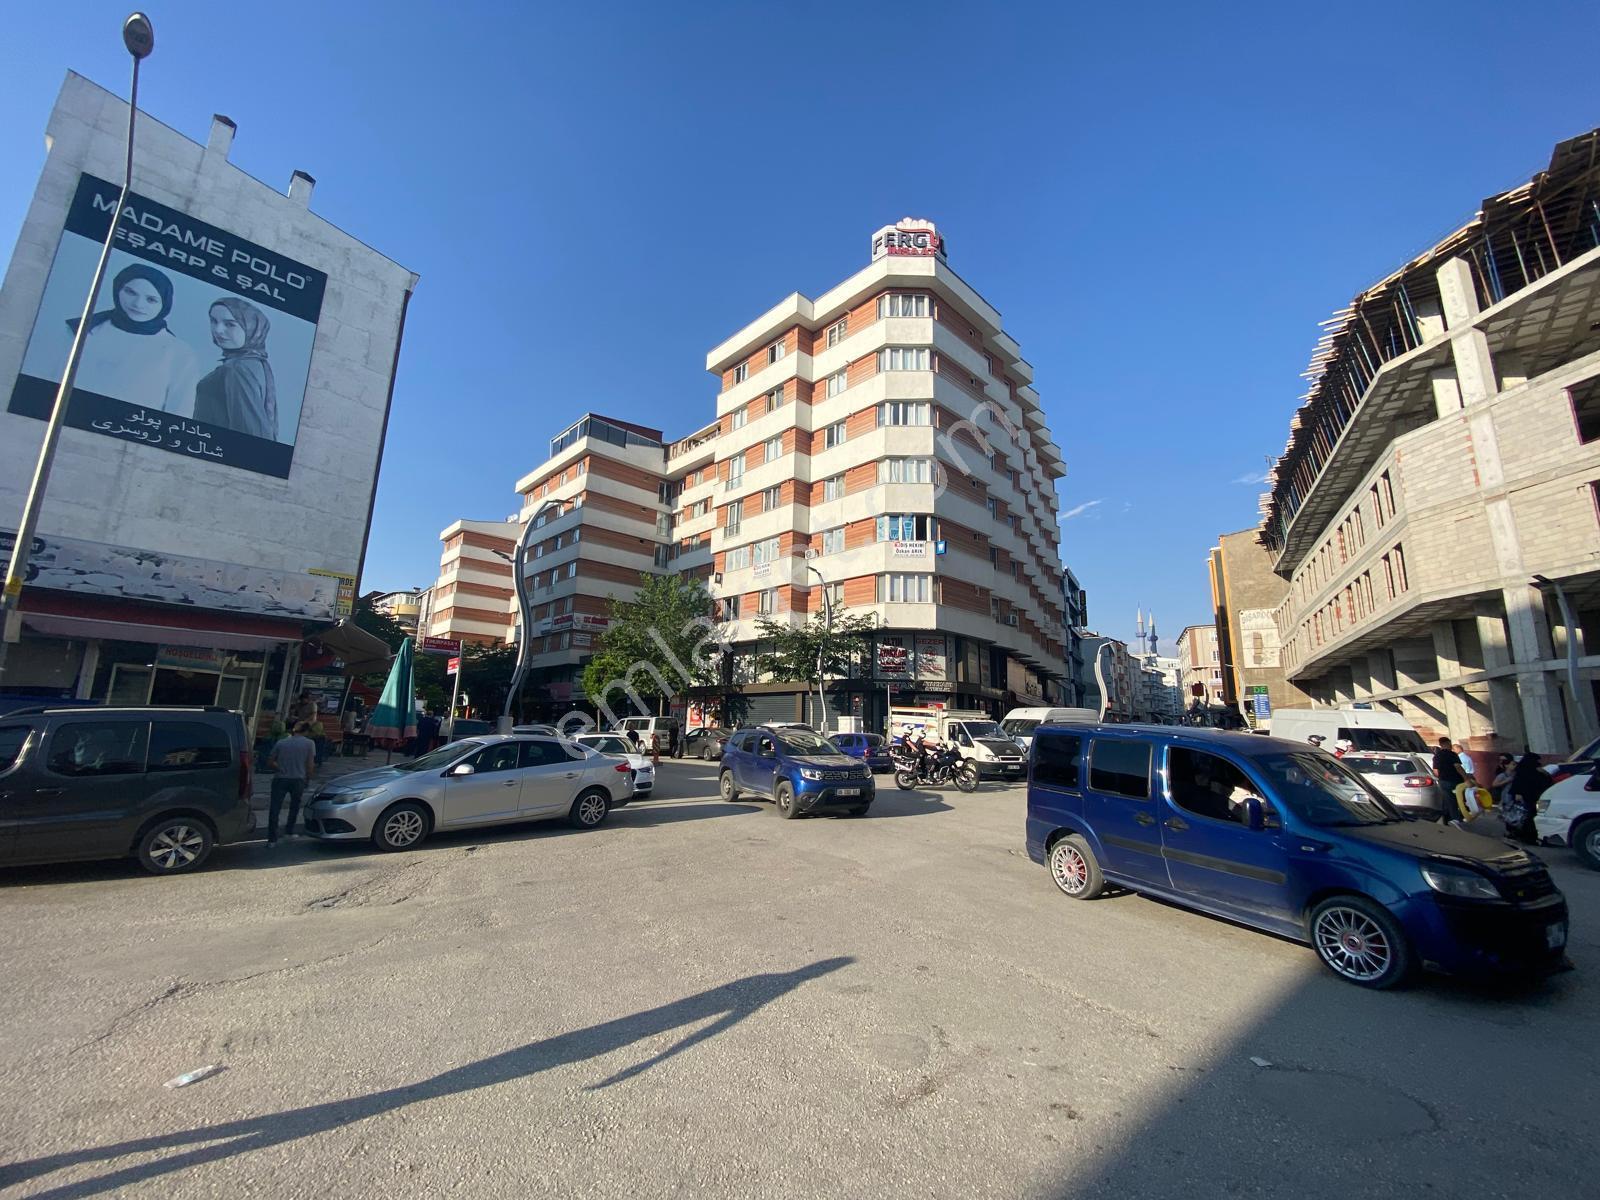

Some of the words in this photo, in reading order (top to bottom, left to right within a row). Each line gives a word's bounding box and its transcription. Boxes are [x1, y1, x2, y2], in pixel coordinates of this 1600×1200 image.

[92, 192, 225, 258] MADAME
[231, 249, 307, 291] POLO
[113, 228, 206, 269] EŞARP
[212, 263, 231, 280] &
[236, 274, 287, 302] ŞAL
[169, 421, 213, 440] مادام
[187, 440, 225, 459] شال
